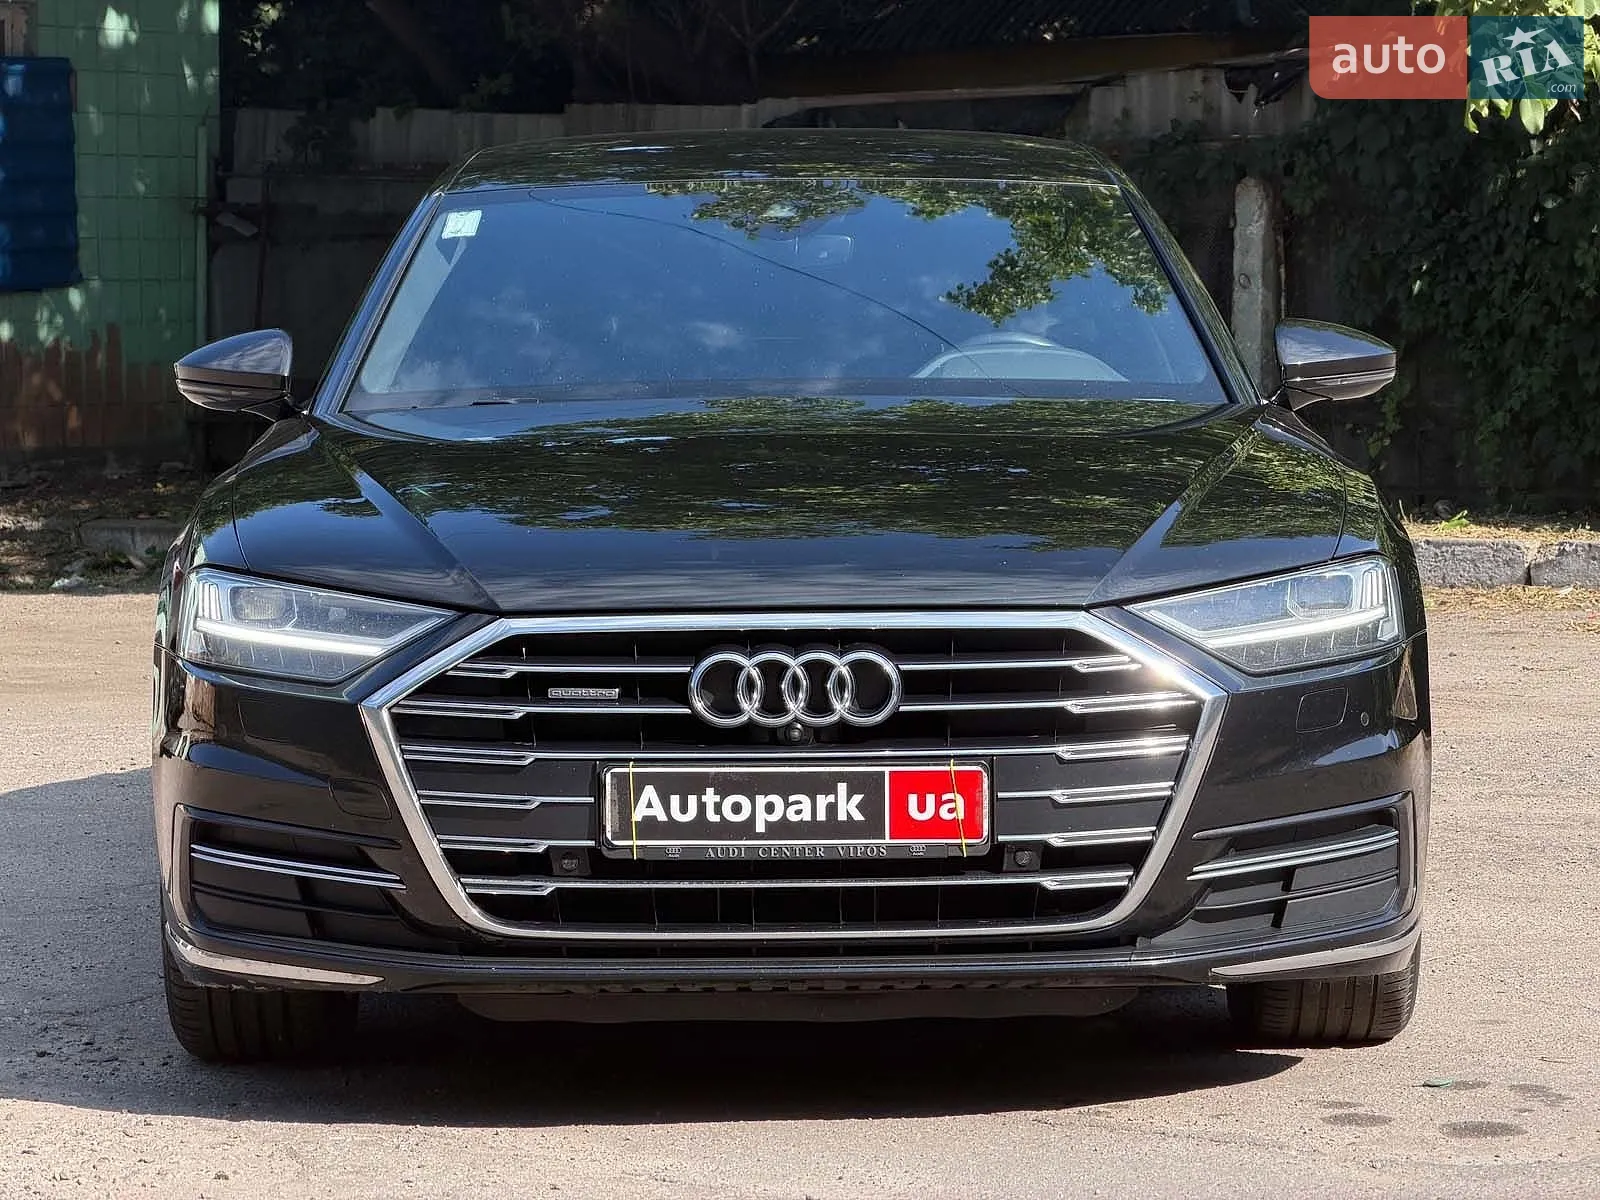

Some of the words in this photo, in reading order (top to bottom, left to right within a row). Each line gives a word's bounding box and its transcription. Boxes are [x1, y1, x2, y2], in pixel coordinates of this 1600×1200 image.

[550, 688, 617, 699] quattro
[634, 782, 866, 833] Autopark
[907, 791, 965, 821] ua
[704, 846, 745, 858] AUDI
[758, 846, 825, 858] CENTER
[836, 844, 888, 857] VIPOS
